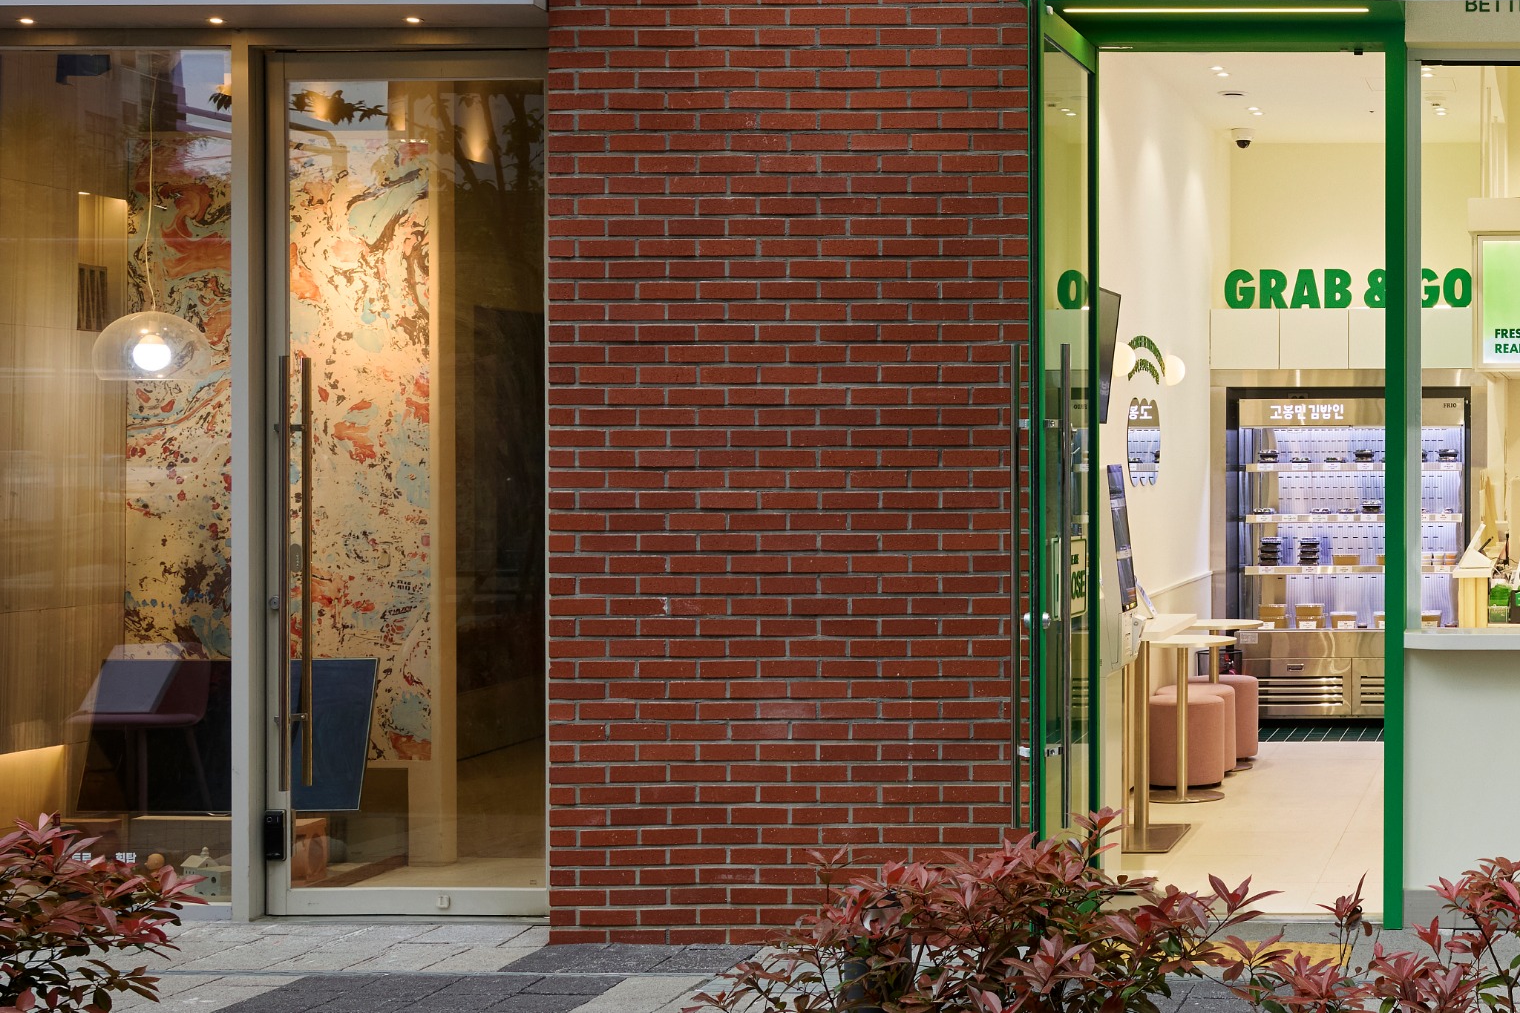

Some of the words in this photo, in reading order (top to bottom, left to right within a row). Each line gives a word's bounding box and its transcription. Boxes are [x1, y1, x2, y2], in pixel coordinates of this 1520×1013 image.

[1224, 268, 1353, 310] GRAB
[1269, 404, 1307, 420] 고봉민
[1308, 404, 1345, 420] 김밥인
